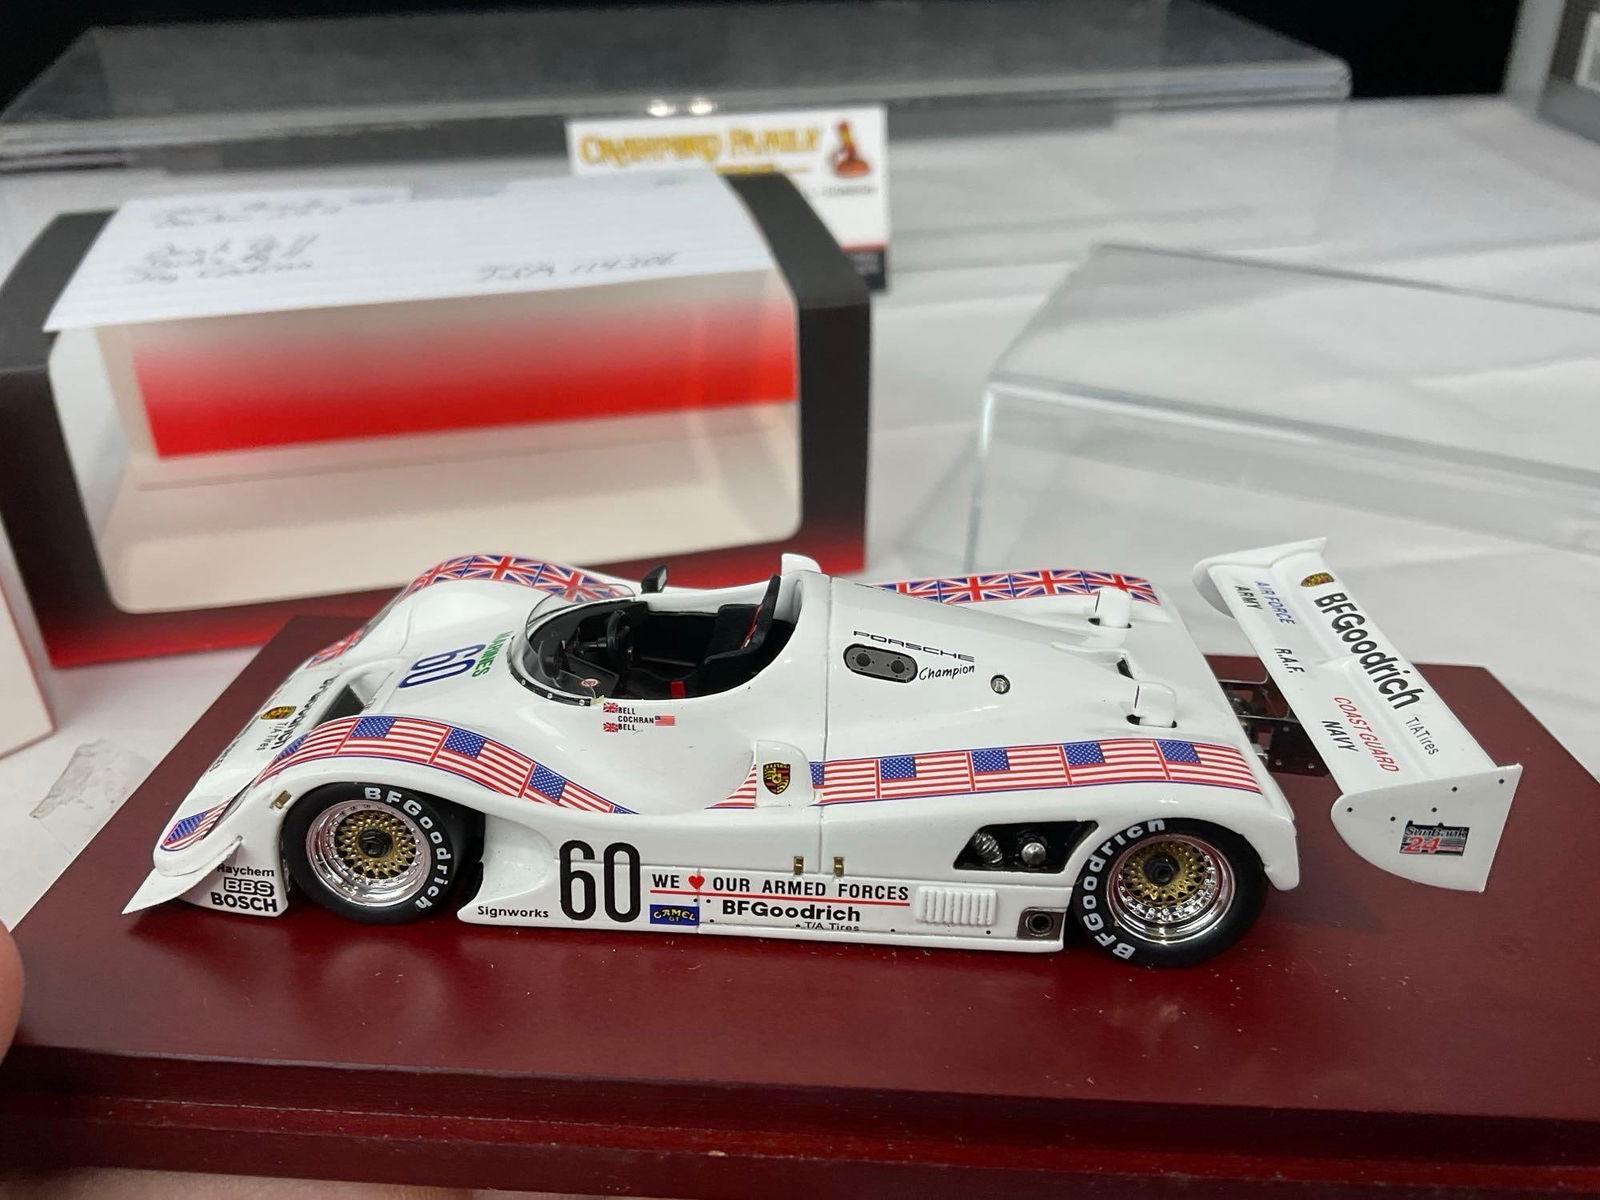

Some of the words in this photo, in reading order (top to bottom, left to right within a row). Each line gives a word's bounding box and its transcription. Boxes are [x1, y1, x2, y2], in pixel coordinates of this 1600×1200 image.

[1235, 586, 1263, 610] ARMY
[1254, 580, 1276, 595] AIR
[1263, 596, 1296, 625] FORCE
[853, 630, 975, 663] PORSCHE
[1314, 592, 1424, 710] BFGoodrich
[398, 644, 487, 688] 60
[1274, 648, 1305, 673] R.A.F.
[919, 664, 975, 681] Champion
[617, 707, 636, 715] BELL
[617, 715, 655, 724] COCHRAN
[617, 723, 637, 732] BELL
[1322, 721, 1359, 752] NAVY
[1334, 697, 1373, 733] COAST
[1359, 732, 1400, 772] GUARD
[1416, 730, 1439, 755] Tires
[364, 786, 451, 910] BFGoodrich
[1401, 835, 1441, 854] 24
[217, 863, 275, 877] Raychem
[559, 840, 641, 923] 60
[224, 877, 275, 898] BBS
[652, 873, 680, 889] WE
[713, 877, 750, 893] OUR
[762, 879, 826, 897] ARMED
[838, 883, 909, 901] FORCES
[1082, 817, 1166, 960] BFGoodrich
[210, 891, 278, 913] BOSCH
[477, 905, 550, 918] Signworks
[722, 899, 861, 922] BFGoodrich
[653, 908, 696, 921] CAMEL
[804, 921, 825, 930] T/A
[828, 922, 861, 932] Tires
